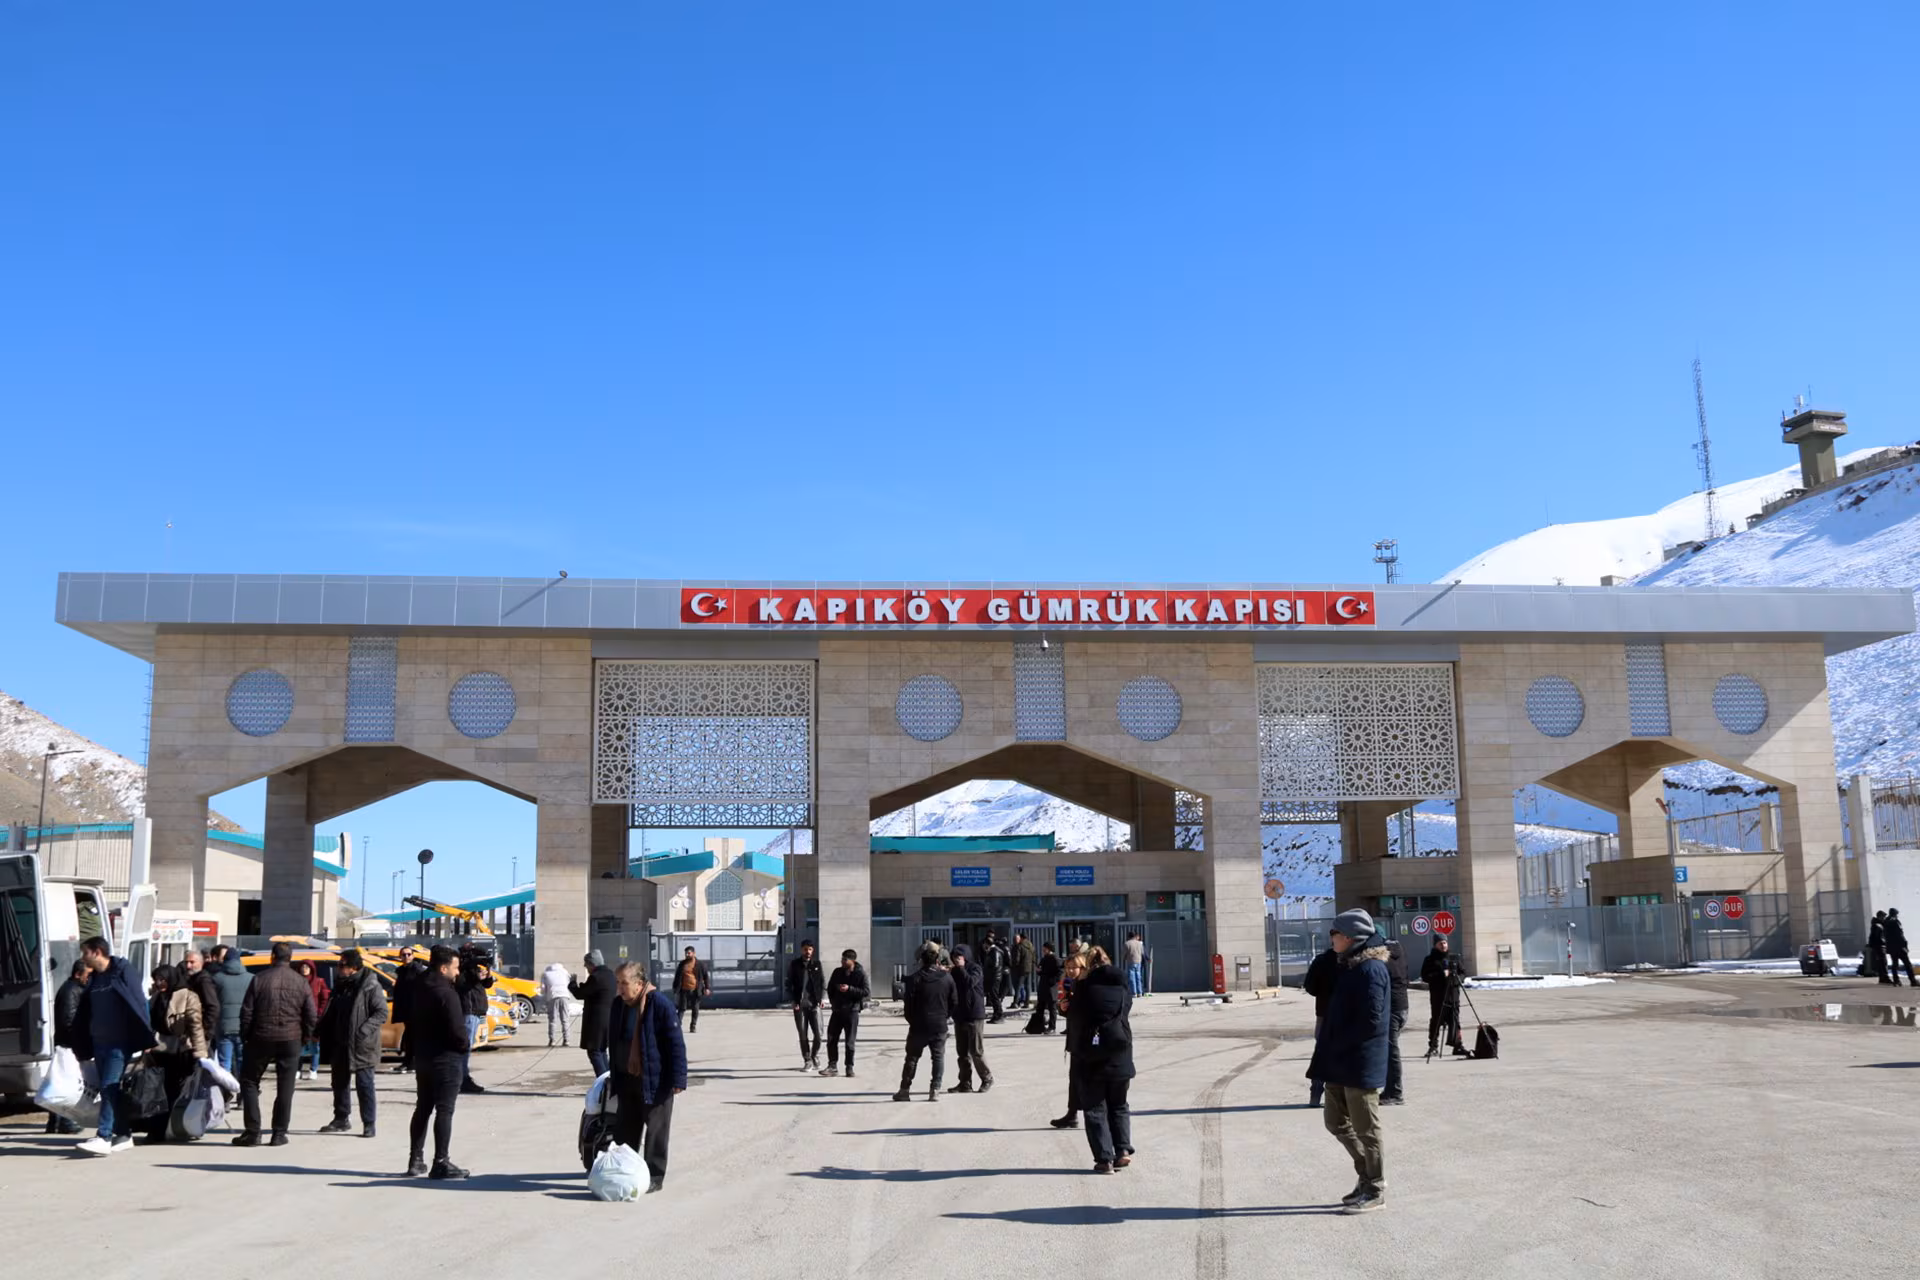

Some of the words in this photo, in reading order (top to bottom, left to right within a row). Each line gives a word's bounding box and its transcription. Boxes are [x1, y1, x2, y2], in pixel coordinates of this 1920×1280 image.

[759, 590, 966, 622] KAPIKÖY
[987, 590, 1160, 622] GÜMRÜK
[1174, 598, 1305, 623] KAPISI
[1677, 871, 1685, 881] 3
[1708, 905, 1718, 913] 30
[1724, 902, 1743, 912] DUR
[1415, 921, 1427, 930] 30
[1433, 918, 1453, 929] DUR
